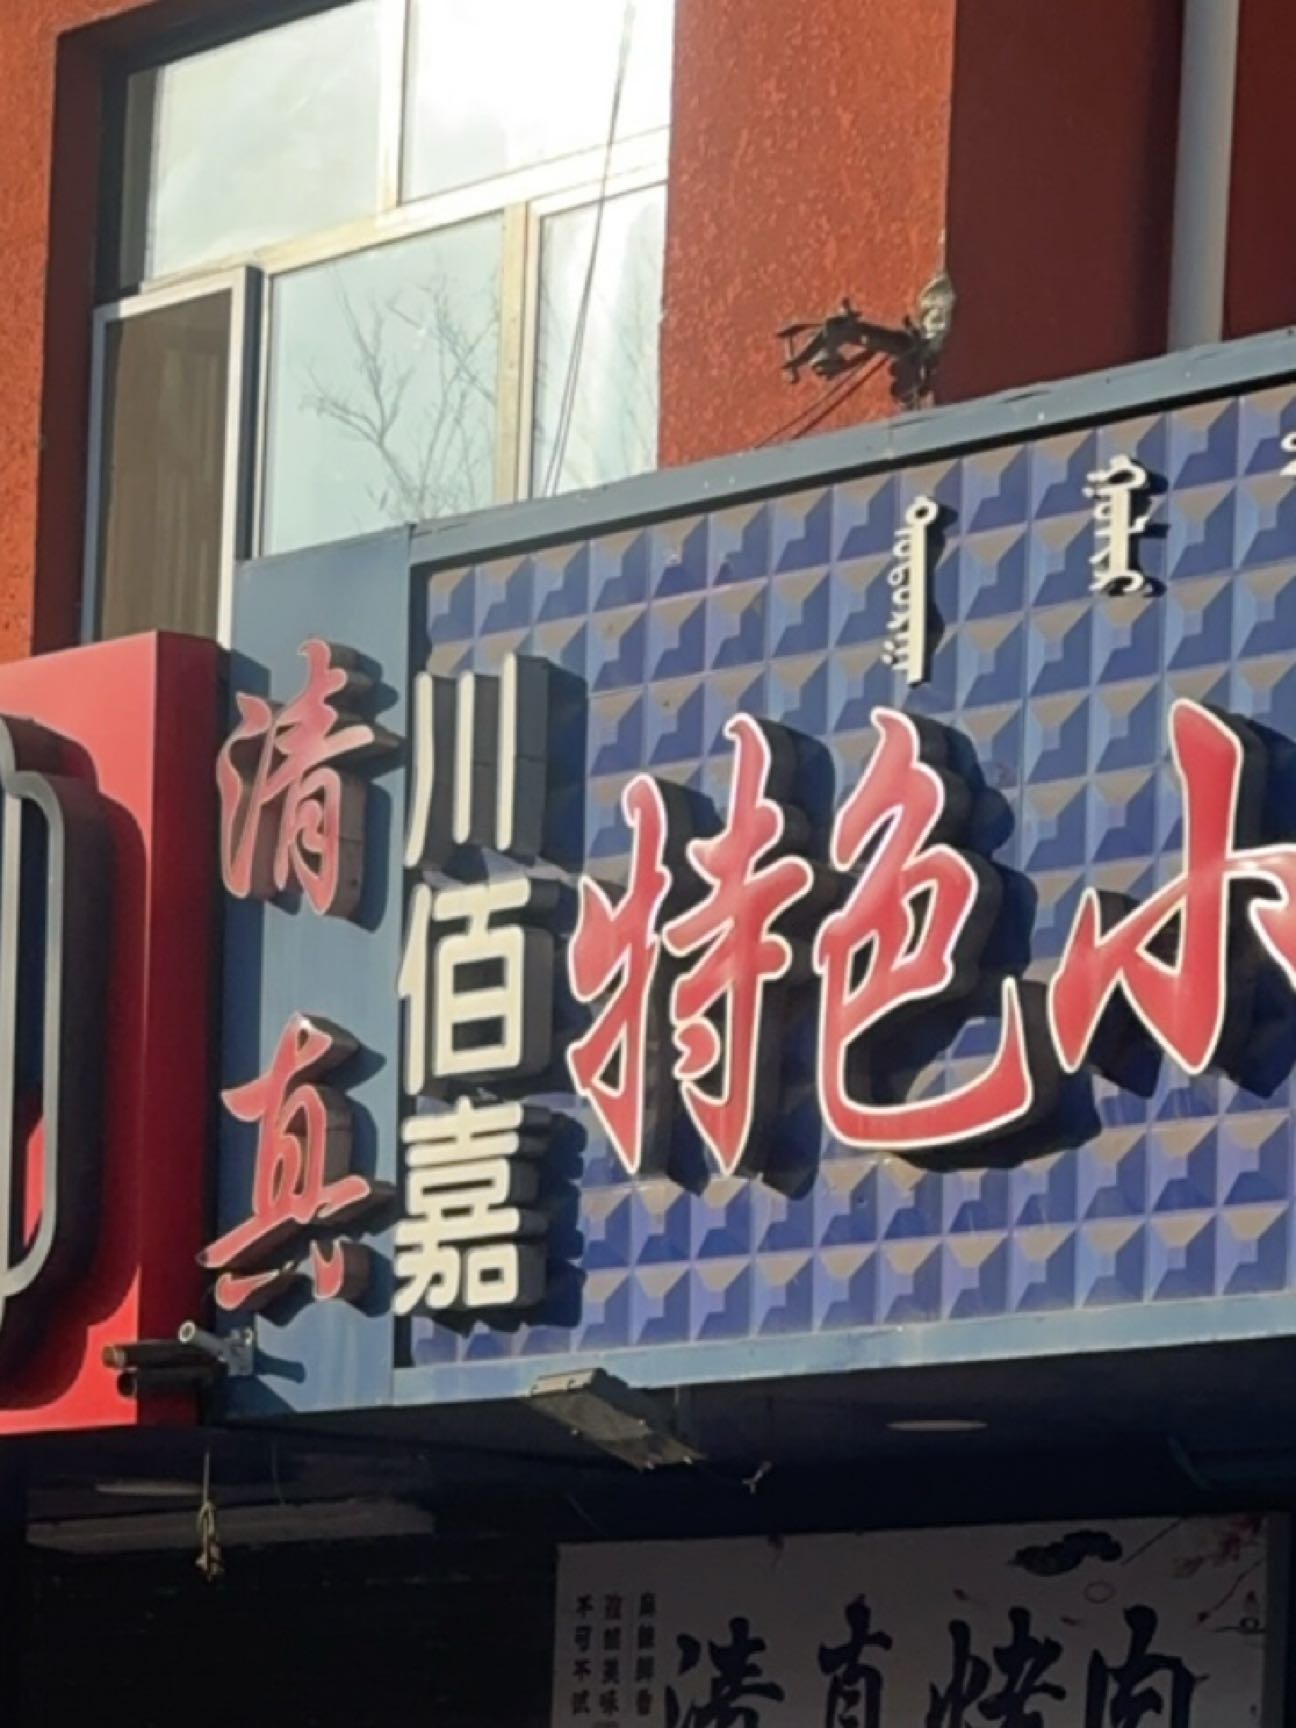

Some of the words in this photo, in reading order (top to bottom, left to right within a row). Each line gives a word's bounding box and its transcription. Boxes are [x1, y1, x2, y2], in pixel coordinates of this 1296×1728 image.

[202, 638, 375, 1313] 清真
[395, 652, 526, 1315] 川佰嘉
